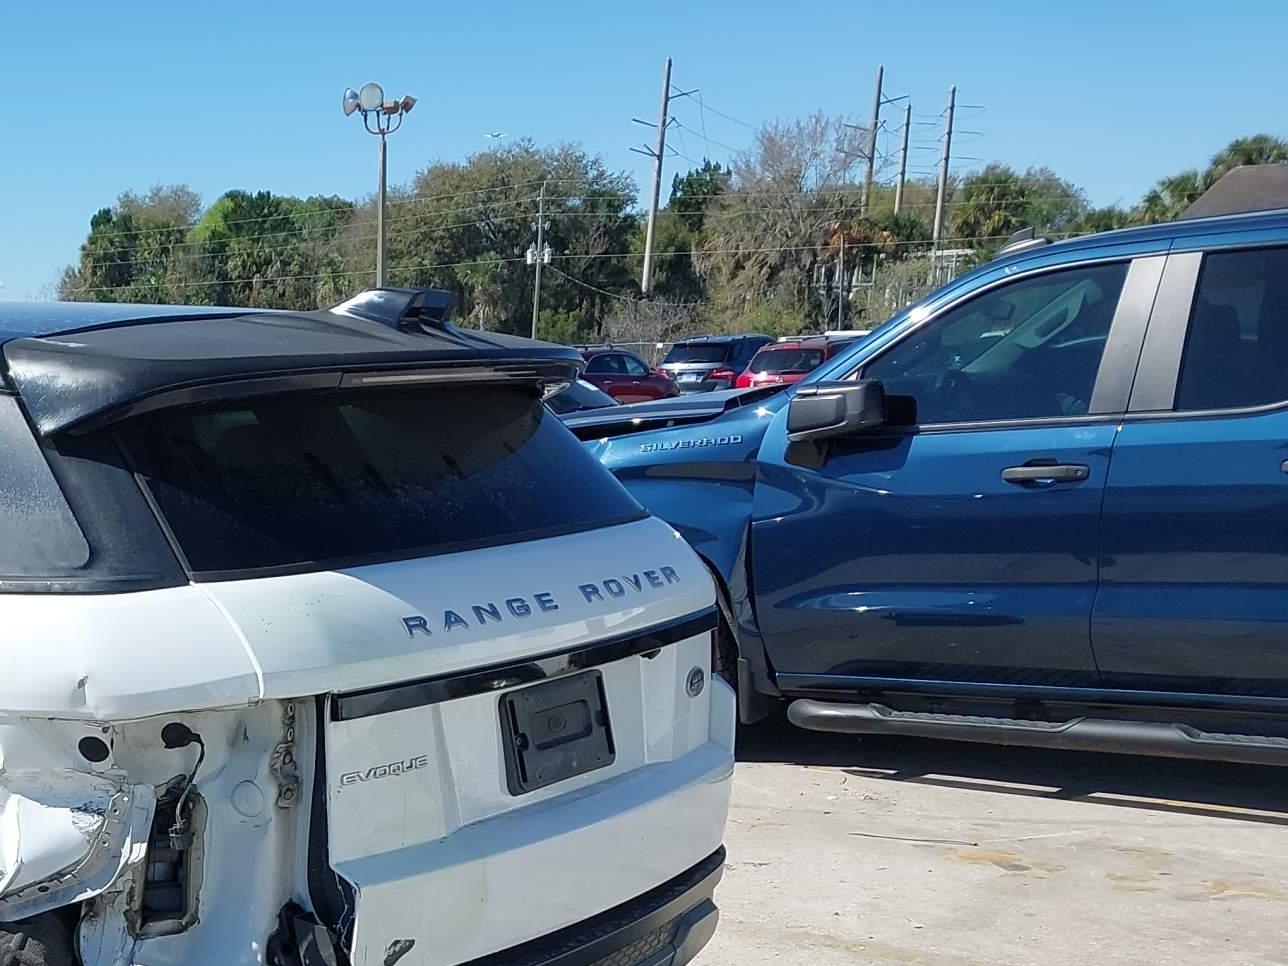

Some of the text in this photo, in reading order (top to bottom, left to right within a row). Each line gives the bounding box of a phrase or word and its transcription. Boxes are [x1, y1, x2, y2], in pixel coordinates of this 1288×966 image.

[640, 435, 743, 453] SILVERADO
[401, 565, 681, 639] RANGE ROVER
[340, 754, 429, 786] EVOQUE
